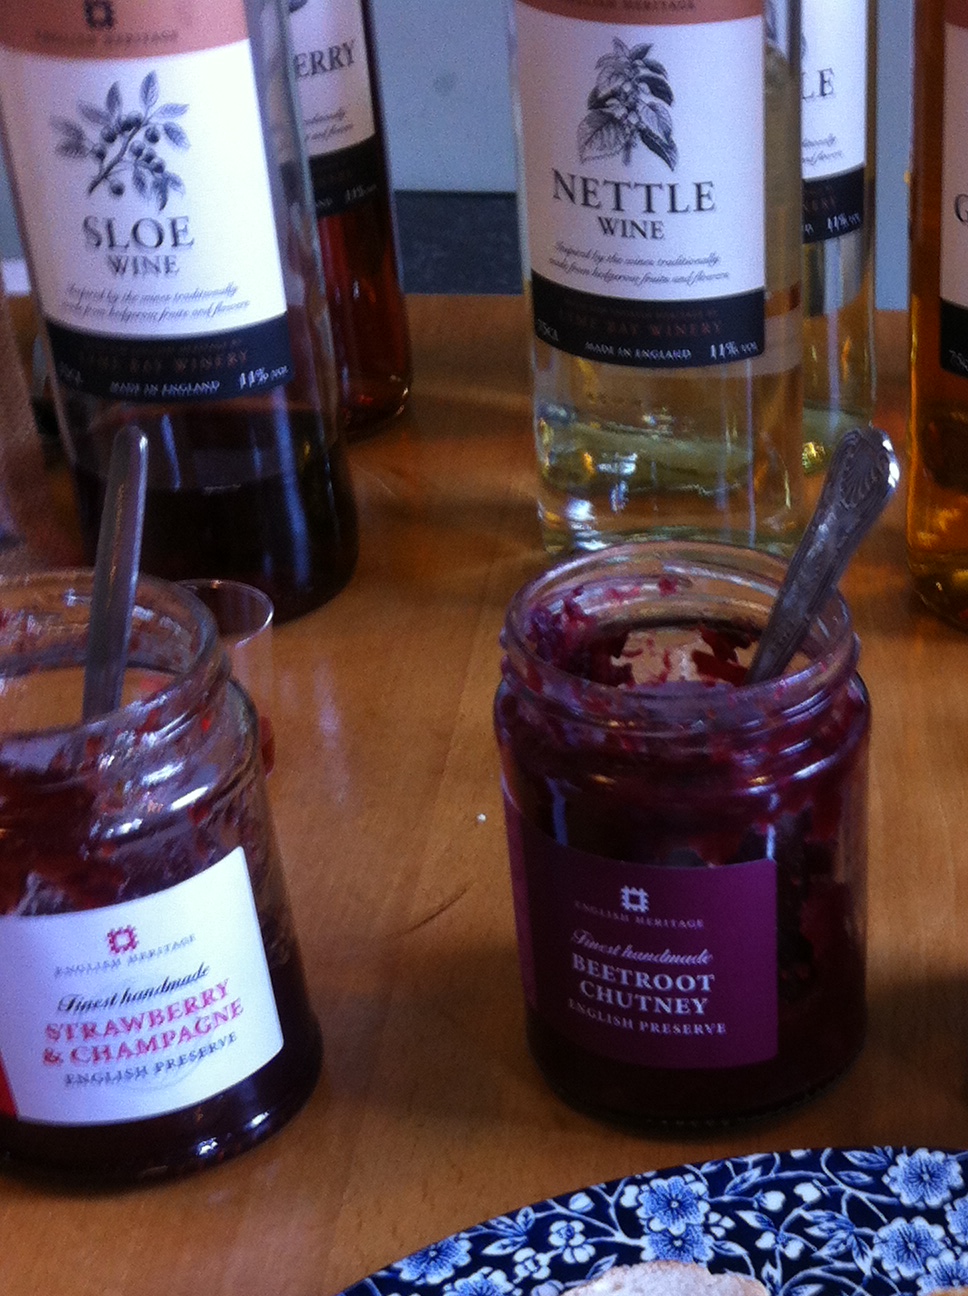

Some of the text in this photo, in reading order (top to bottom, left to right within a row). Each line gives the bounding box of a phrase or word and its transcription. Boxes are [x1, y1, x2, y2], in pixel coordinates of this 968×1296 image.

[552, 168, 715, 213] NETTLE
[82, 215, 195, 250] SLOE
[597, 215, 665, 240] WINE
[106, 255, 180, 277] WINE
[575, 900, 705, 929] ENGLISH HERITAGE
[54, 933, 197, 979] ENGLISH HERITAGE
[571, 929, 714, 966] Finest handmade
[118, 961, 211, 1008] handmade
[571, 952, 717, 994] BEETROOT
[45, 978, 231, 1043] STRAWBERRY
[567, 998, 728, 1036] ENGLISH PRESERVE
[579, 979, 708, 1017] CHUTNEY
[43, 997, 245, 1068] & CHAMPAGNE
[65, 1031, 238, 1087] ENGLISH PRESERVE
